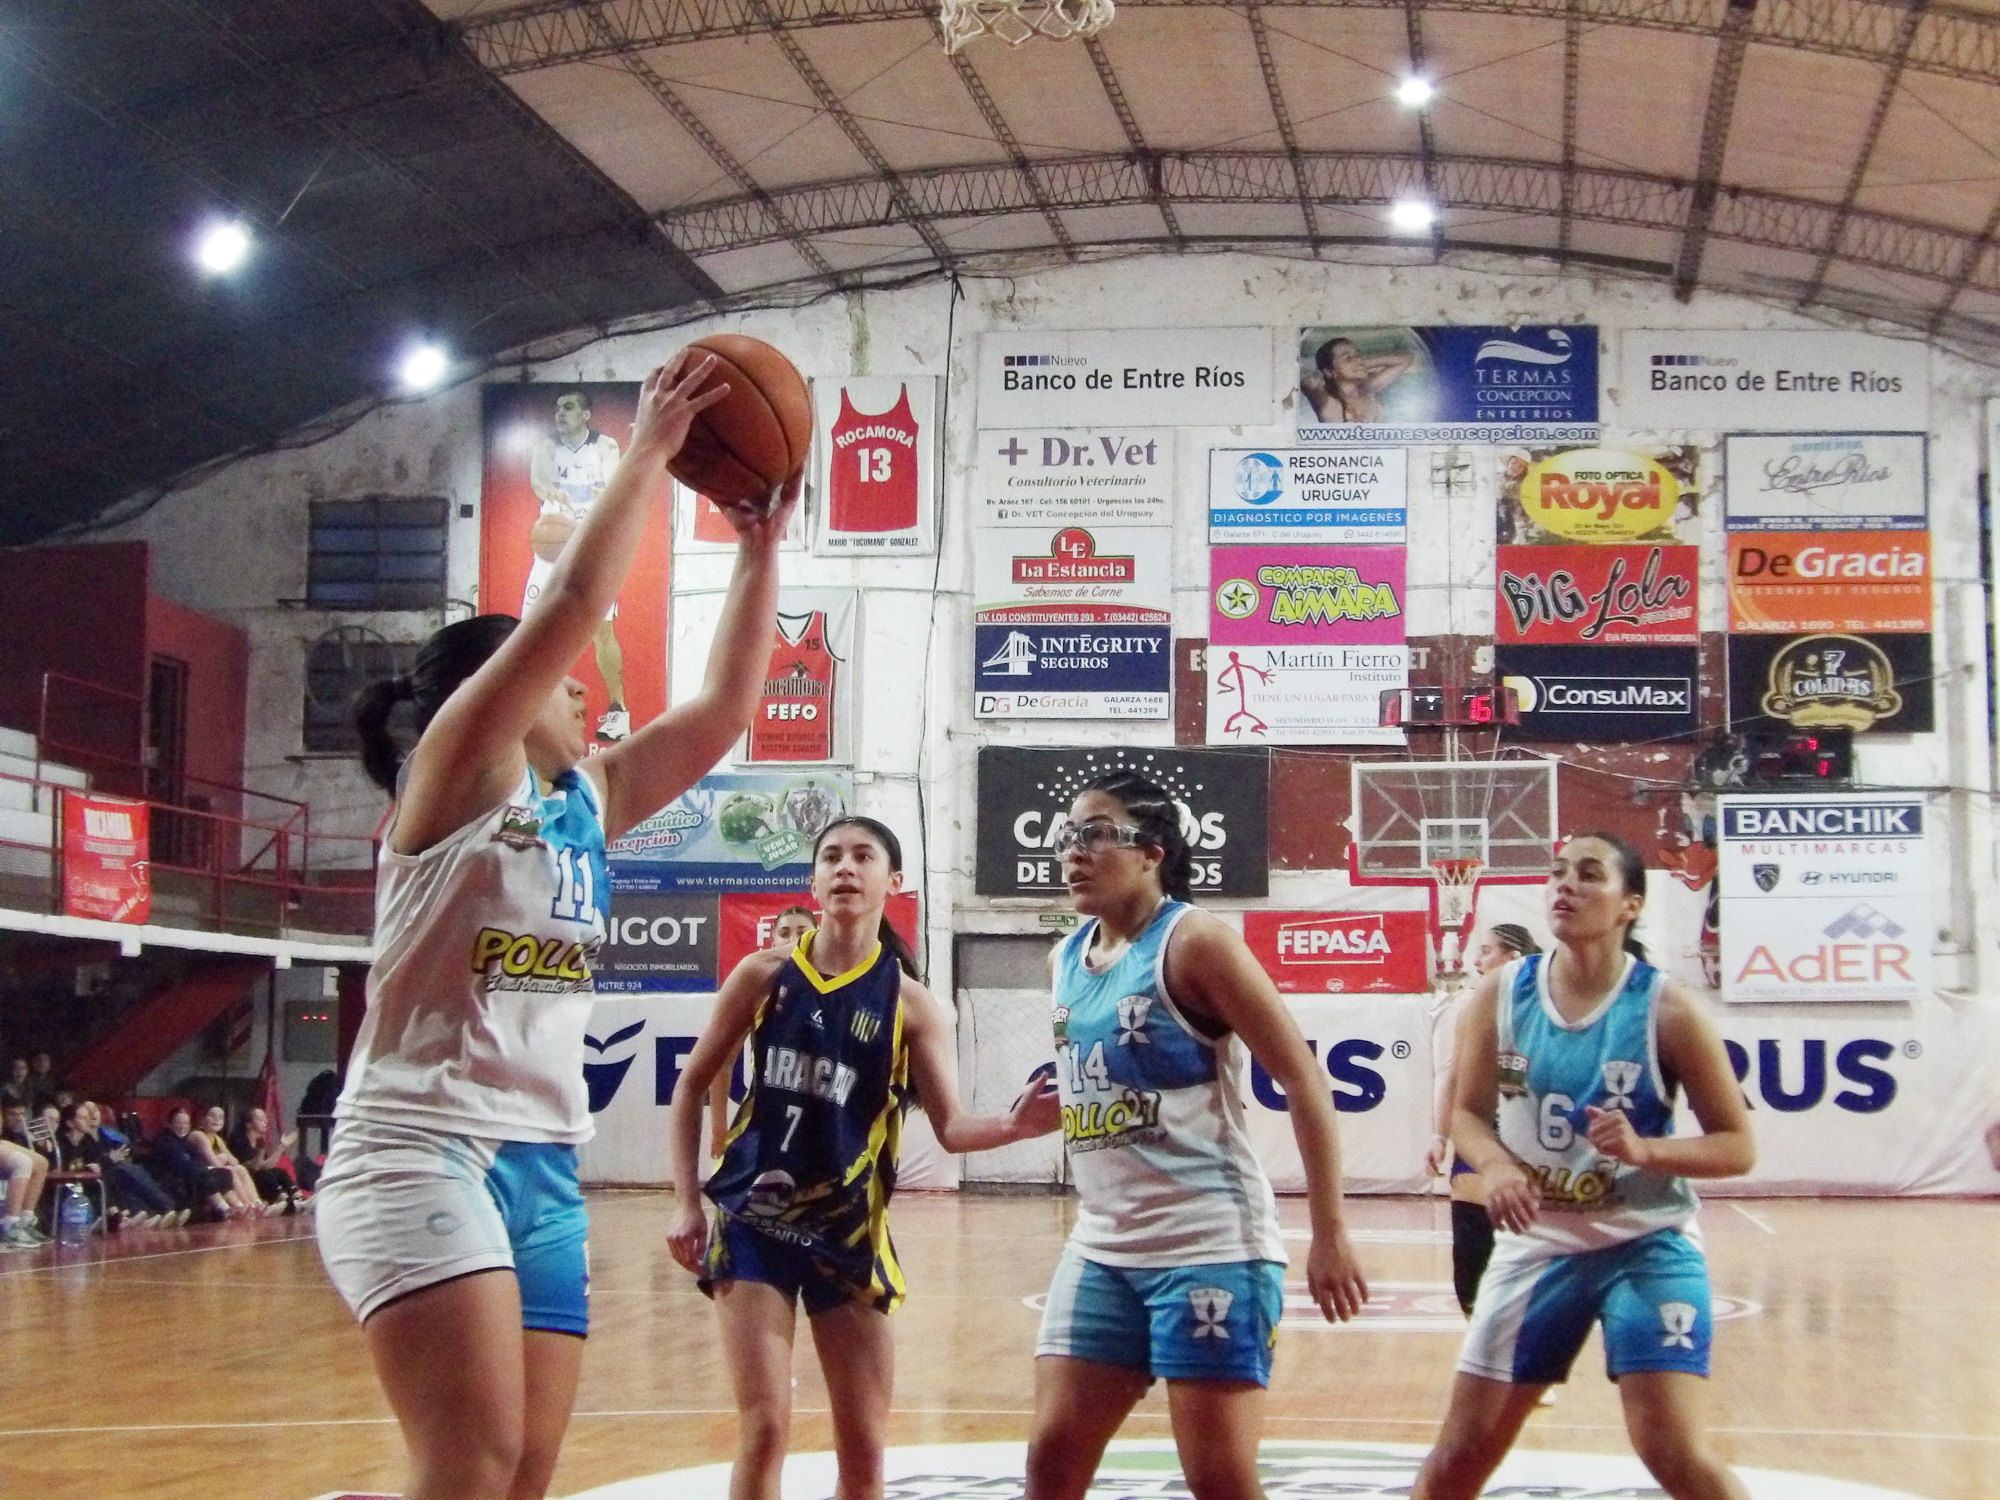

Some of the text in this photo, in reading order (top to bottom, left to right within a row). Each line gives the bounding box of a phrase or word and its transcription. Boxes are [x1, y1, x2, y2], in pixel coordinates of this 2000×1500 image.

[1051, 355, 1087, 366] Nuevo
[1701, 355, 1738, 367] Nuevo
[1004, 365, 1245, 390] Banco de Entre Ríos
[1475, 369, 1572, 384] TERMAS
[1651, 369, 1903, 393] Banco de Entre Ríos
[1476, 390, 1571, 402] CONCEPCION
[1476, 409, 1527, 419] ENTRE
[835, 425, 915, 449] ROCAMORA
[1298, 424, 1600, 443] www.termasconcepcion.com
[857, 447, 893, 483] 13
[1288, 455, 1384, 469] RESONANCIA
[1007, 474, 1146, 488] Consultorio Veterinario
[1293, 471, 1379, 485] MAGNETICA
[1574, 471, 1645, 480] FOTO OPTICA
[1301, 488, 1371, 502] URUGUAY
[1540, 470, 1661, 521] Royal
[1026, 510, 1043, 518] VET
[1213, 511, 1402, 523] DIAGNOSTICO POR IMAGENES
[828, 537, 848, 547] MARIO
[1060, 535, 1086, 559] LE
[1021, 561, 1126, 578] La Estancia
[1736, 546, 1925, 577] DeGracia
[1258, 565, 1360, 589] COMPARSA
[1023, 585, 1123, 598] Sabemos de Carne
[1580, 547, 1690, 639] Lola
[991, 612, 1008, 623] LOS
[1008, 612, 1079, 623] CONSTITUYENTES
[1080, 612, 1095, 623] 293
[805, 638, 820, 651] 15
[1040, 657, 1109, 669] SEGUROS
[1266, 648, 1334, 668] Martín
[1342, 649, 1401, 668] Fierro
[1823, 650, 1846, 676] 7
[1349, 671, 1401, 682] Instituto
[1016, 694, 1089, 708] DeGracia
[1104, 696, 1142, 704] GALARZA
[1304, 694, 1340, 703] LUGAR
[1548, 685, 1686, 706] ConsuMax
[767, 703, 818, 721] FEFO
[1128, 707, 1158, 715] 441399
[1736, 808, 1911, 834] BANCHIK
[607, 832, 679, 852] ncepción
[1741, 842, 1908, 856] MULTIMARCAS
[1017, 862, 1050, 884] DE
[1829, 871, 1898, 883] HYUNDAI
[552, 845, 596, 925] 11
[601, 916, 708, 946] IGOT
[1277, 929, 1392, 955] FEPASA
[472, 926, 593, 980] POLL
[614, 963, 648, 971] NEGOCIOS
[649, 963, 699, 971] INMOBILIARIOS
[1735, 943, 1915, 984] AdER
[598, 981, 625, 991] MITRE
[626, 981, 642, 990] 924
[1069, 1040, 1112, 1094] 14
[780, 1104, 803, 1153] 7
[1061, 1100, 1133, 1141] OLLO
[1538, 1092, 1576, 1153] 6
